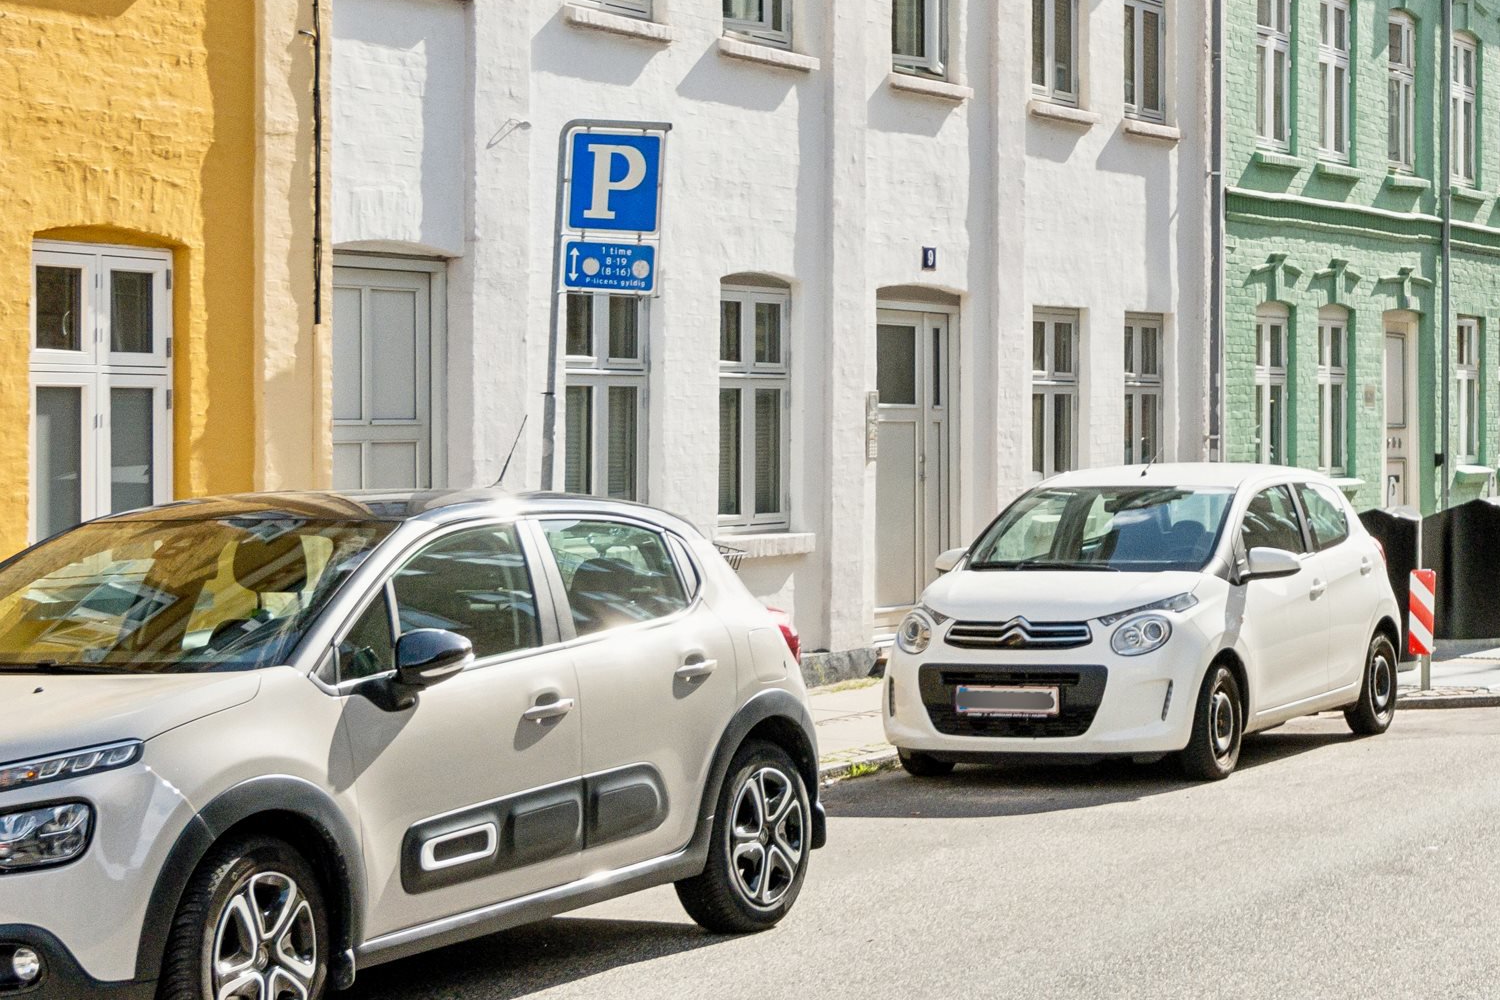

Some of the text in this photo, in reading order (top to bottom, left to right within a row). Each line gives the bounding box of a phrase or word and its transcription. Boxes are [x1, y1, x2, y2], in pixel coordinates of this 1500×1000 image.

[583, 143, 647, 220] P
[601, 246, 632, 256] 1 time
[605, 256, 628, 266] 8-19
[927, 249, 934, 266] 9
[601, 267, 631, 277] (8-16)
[585, 277, 646, 288] P-licens gyldig
